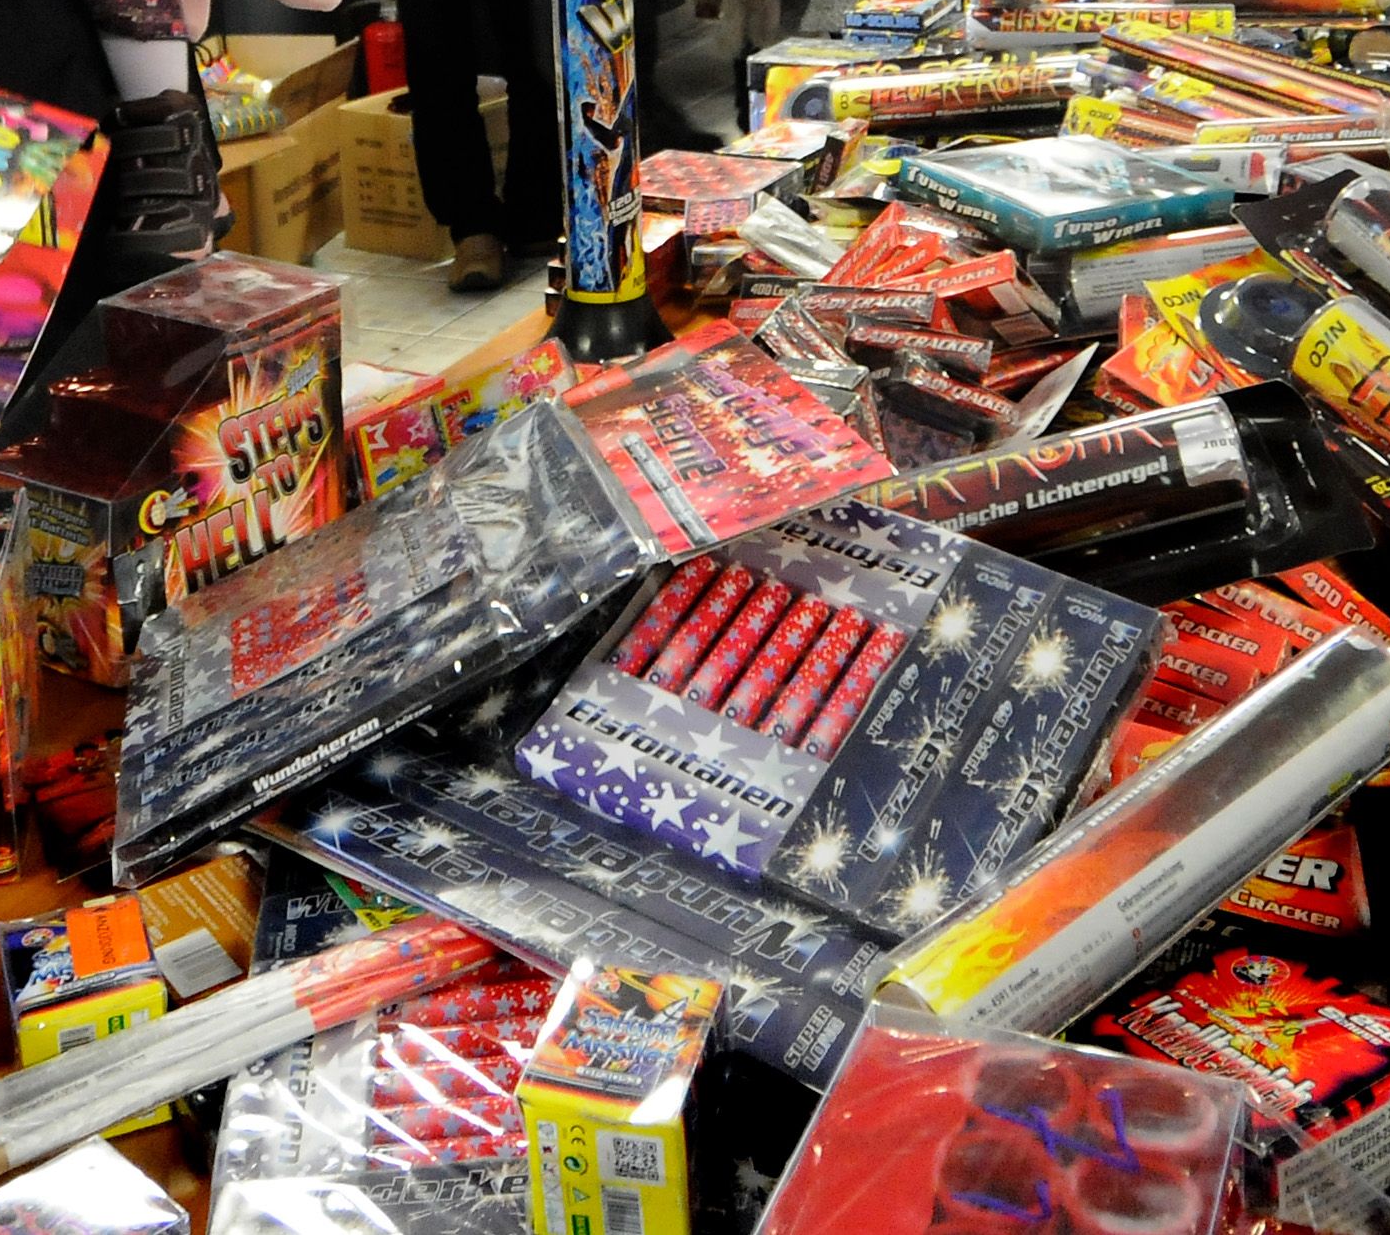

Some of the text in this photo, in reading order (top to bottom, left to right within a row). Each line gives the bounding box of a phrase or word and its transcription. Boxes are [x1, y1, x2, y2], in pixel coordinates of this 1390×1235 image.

[1309, 320, 1347, 368] NICO
[218, 388, 326, 484] STEPS
[256, 453, 297, 503] TO
[1025, 457, 1170, 512] Lichterorgel
[176, 488, 288, 596] HELL
[773, 520, 942, 592] Eisfontän
[976, 571, 1014, 593] NICO
[1217, 584, 1261, 613] 00
[1301, 571, 1344, 606] 400
[1067, 603, 1108, 625] NICO
[1167, 610, 1260, 655] CRACKER
[1158, 653, 1229, 687] ACKER
[857, 586, 1046, 863] Wunderkerzen
[1141, 697, 1195, 725] CKER
[252, 715, 381, 775] Wunderkerzen
[564, 698, 797, 820] Eisfontänen
[1228, 888, 1341, 931] CRACKER
[832, 941, 879, 996] SUPER
[784, 1004, 833, 1069] SUPER
